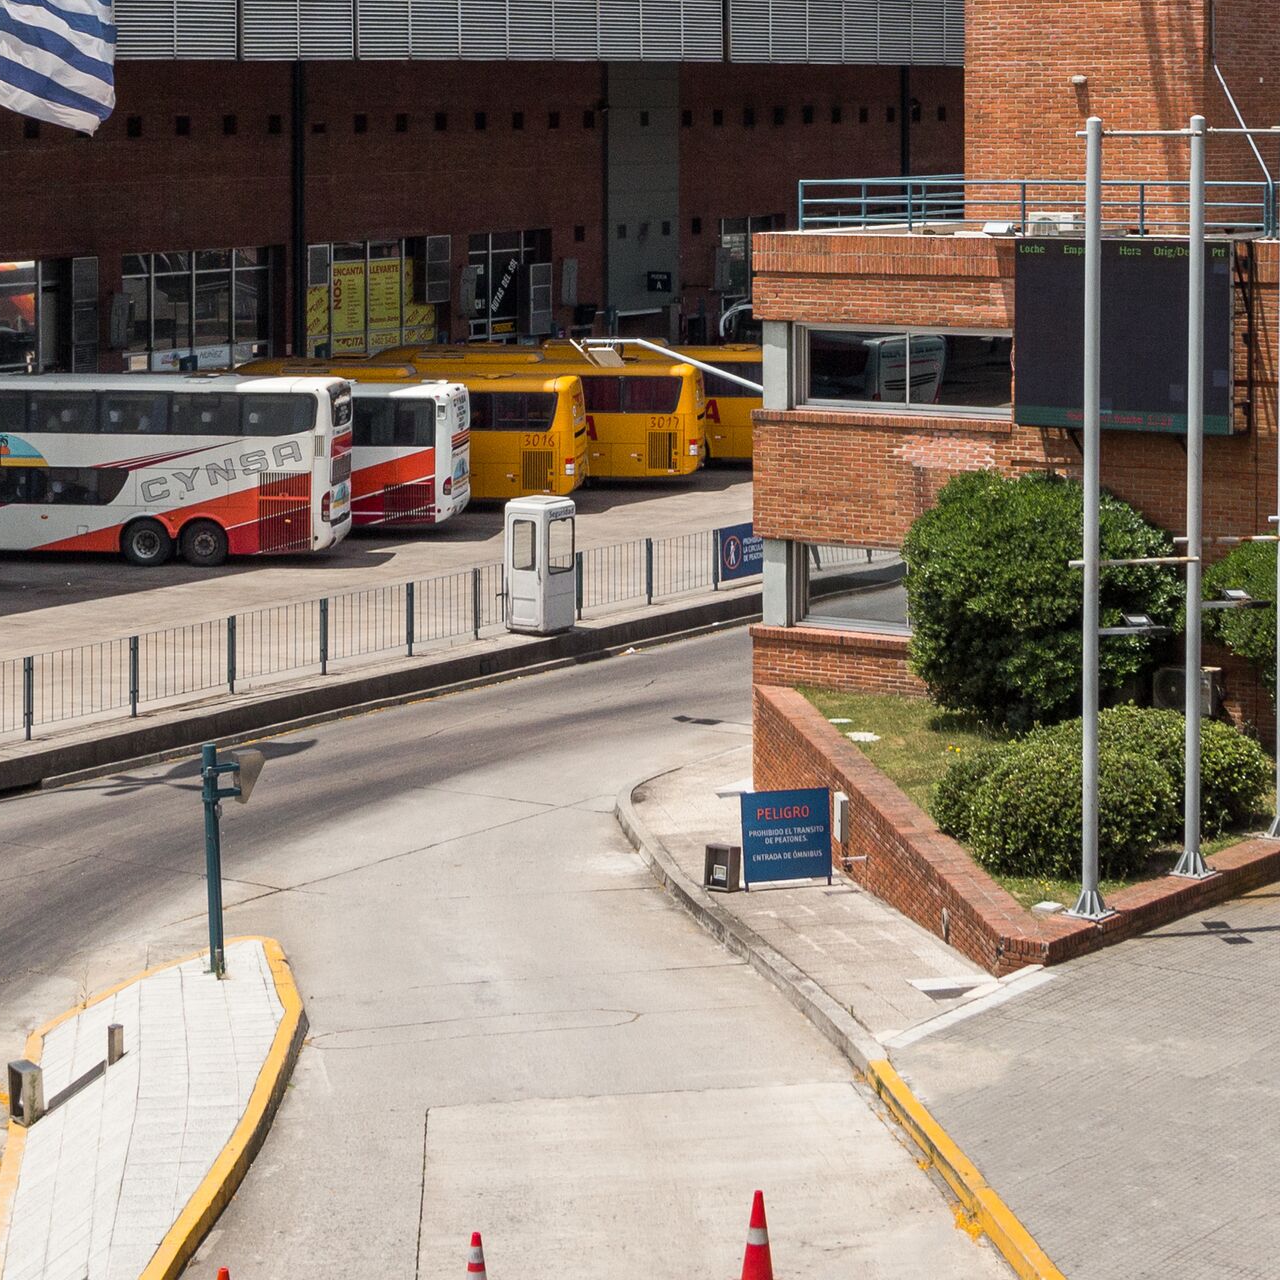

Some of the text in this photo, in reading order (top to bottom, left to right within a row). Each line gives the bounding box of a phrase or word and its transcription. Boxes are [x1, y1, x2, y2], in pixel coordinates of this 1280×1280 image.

[333, 266, 364, 277] ENCANTA
[369, 264, 399, 275] LLEVARTE
[656, 281, 662, 290] A
[333, 279, 342, 310] NOS
[490, 287, 505, 312] RUTAS
[501, 274, 512, 288] DEL
[650, 416, 680, 429] 3017
[524, 433, 555, 448] 3016
[140, 441, 303, 502] CYNSA
[756, 805, 810, 821] PELIGRO
[749, 825, 824, 837] PROHIBIDO EL TRANSITO
[765, 837, 773, 845] DE
[752, 853, 782, 862] ENTRADA
[793, 849, 822, 859] ÓMNIBUS
